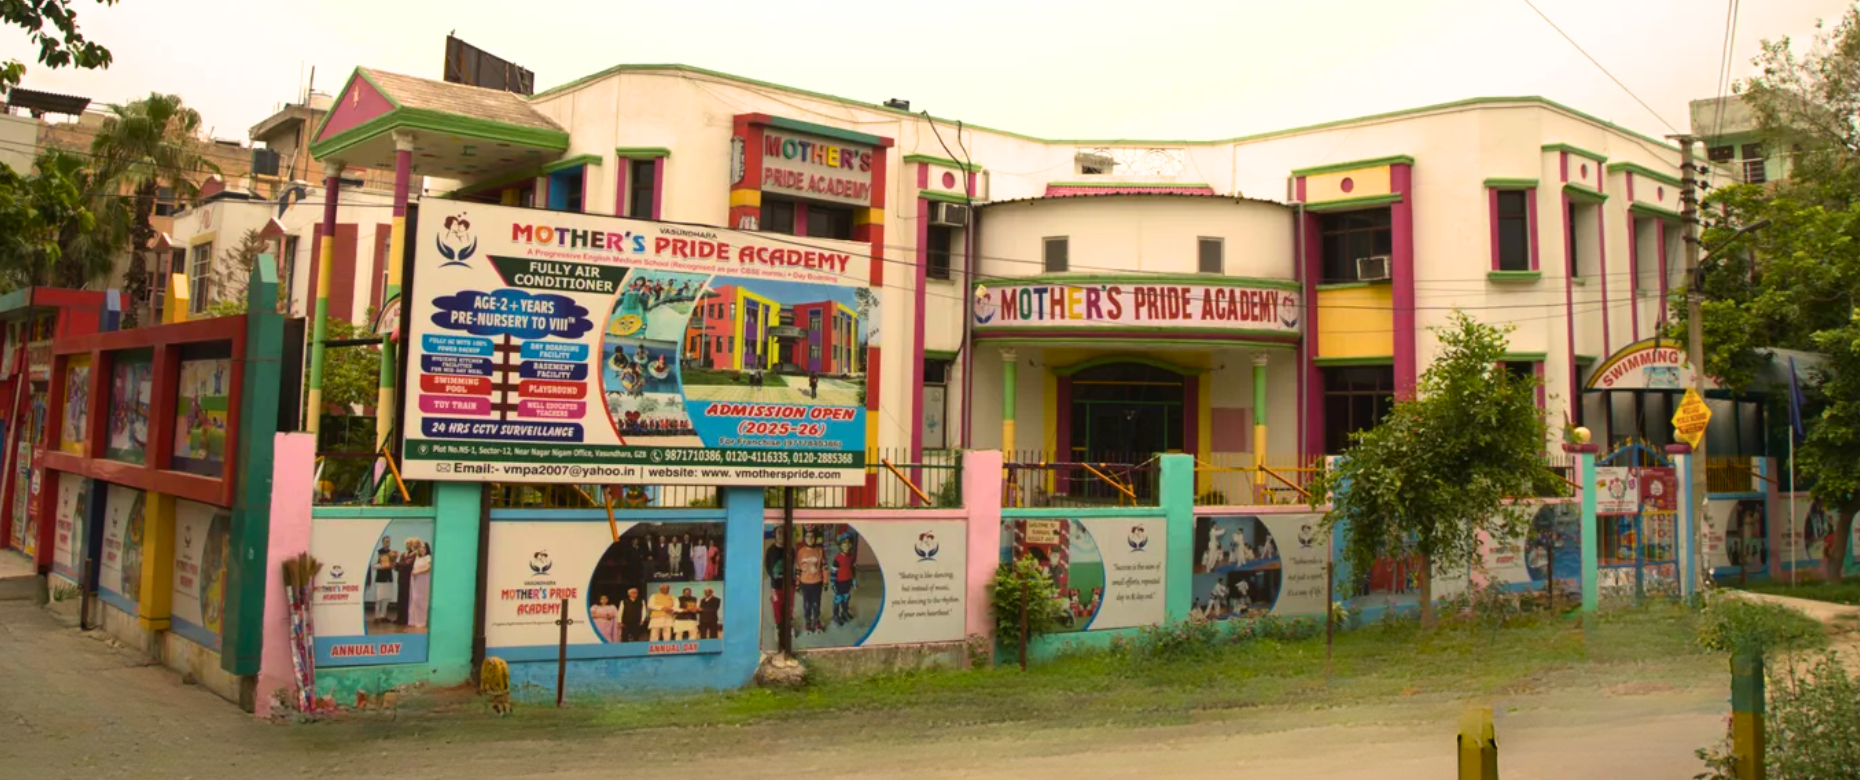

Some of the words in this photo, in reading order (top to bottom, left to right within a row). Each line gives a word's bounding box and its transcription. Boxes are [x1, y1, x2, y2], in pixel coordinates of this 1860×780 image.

[764, 134, 872, 172] MOTHER'S
[764, 167, 805, 191] PRIDE
[806, 174, 872, 200] ACADEMY
[659, 227, 717, 239] VASUNDHARA
[511, 223, 645, 253] MOTHER'S
[655, 236, 730, 260] PRIDE
[738, 246, 850, 273] ACADEMY
[529, 262, 572, 275] FULLY
[575, 266, 600, 278] AIR
[535, 250, 582, 261] Progressive
[583, 254, 610, 263] English
[612, 256, 642, 265] Medium
[644, 258, 669, 267] School
[727, 267, 739, 275] per
[793, 271, 806, 280] Day
[807, 273, 838, 283] Boarding
[514, 273, 613, 292] CONDITIONER
[474, 296, 507, 311] AGE-2
[520, 299, 554, 314] YEARS
[1000, 284, 1122, 321] MOTHER'S
[1134, 286, 1193, 320] PRIDE
[1201, 287, 1279, 323] ACADEMY
[450, 310, 528, 329] PRE-NURSERY
[531, 316, 546, 330] TO
[530, 342, 543, 350] DAY
[545, 344, 580, 353] BOARDING
[539, 351, 570, 359] FACILITY
[533, 362, 575, 371] BASEMENT
[1602, 350, 1678, 387] SWIMMING
[433, 376, 479, 386] SWIMMING
[536, 370, 571, 379] FACILITY
[445, 385, 467, 393] POOL
[528, 384, 578, 395] PLAYGROUND
[434, 400, 451, 409] TOY
[452, 401, 477, 410] TRAIN
[527, 401, 545, 409] WELL
[546, 402, 578, 410] EDUCATED
[705, 403, 806, 419] ADMISSION
[809, 406, 856, 420] OPEN
[535, 409, 568, 417] TEACHERS
[431, 422, 445, 433] 24
[448, 422, 470, 434] HRS
[472, 423, 497, 435] CCTV
[500, 424, 574, 437] SURVEILLANCE
[737, 421, 826, 437] (2025-26)
[719, 437, 734, 445] For
[737, 437, 781, 447] Franchise
[432, 445, 446, 453] Plot
[513, 447, 530, 455] Near
[531, 448, 550, 458] Nagar
[552, 448, 572, 458] Nigam
[573, 448, 594, 457] Office,
[595, 449, 633, 459] Vasundhara,
[664, 449, 723, 464] 9871710386,
[726, 451, 791, 465] 0120-4116335,
[503, 464, 636, 478] vmpa2007@yahoo.in
[648, 467, 697, 478] website:
[701, 469, 731, 478] www.
[735, 469, 841, 481] vmotherspride.com
[501, 587, 547, 600] MOTHER'S
[549, 587, 578, 600] PRIDE
[517, 602, 561, 616] ACADEMY
[330, 644, 376, 657] ANNUAL
[379, 643, 402, 655] DAY
[648, 643, 680, 653] ANNUAL
[682, 643, 699, 652] DAY
